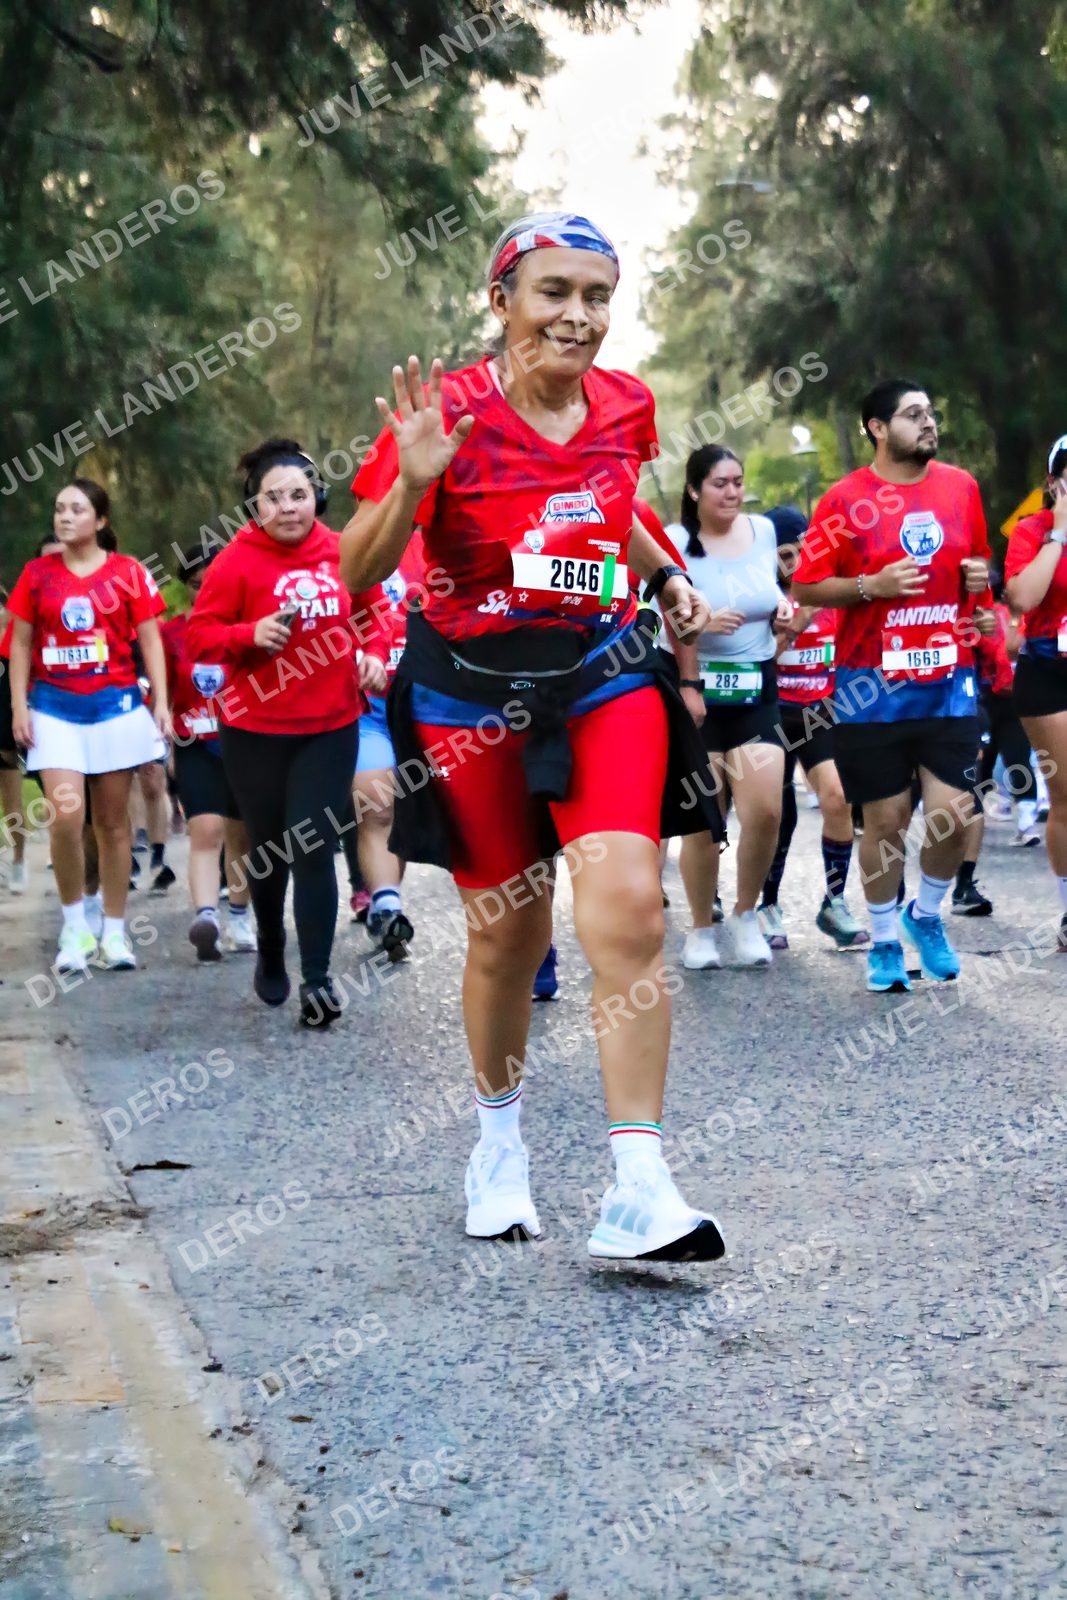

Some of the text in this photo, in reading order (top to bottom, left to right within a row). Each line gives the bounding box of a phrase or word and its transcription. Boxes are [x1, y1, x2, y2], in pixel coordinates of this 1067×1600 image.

[552, 500, 589, 511] BIMBO
[550, 559, 600, 593] 2646
[477, 589, 513, 616] SA
[798, 649, 822, 664] 2271
[907, 650, 940, 667] 1669
[715, 674, 739, 689] 282
